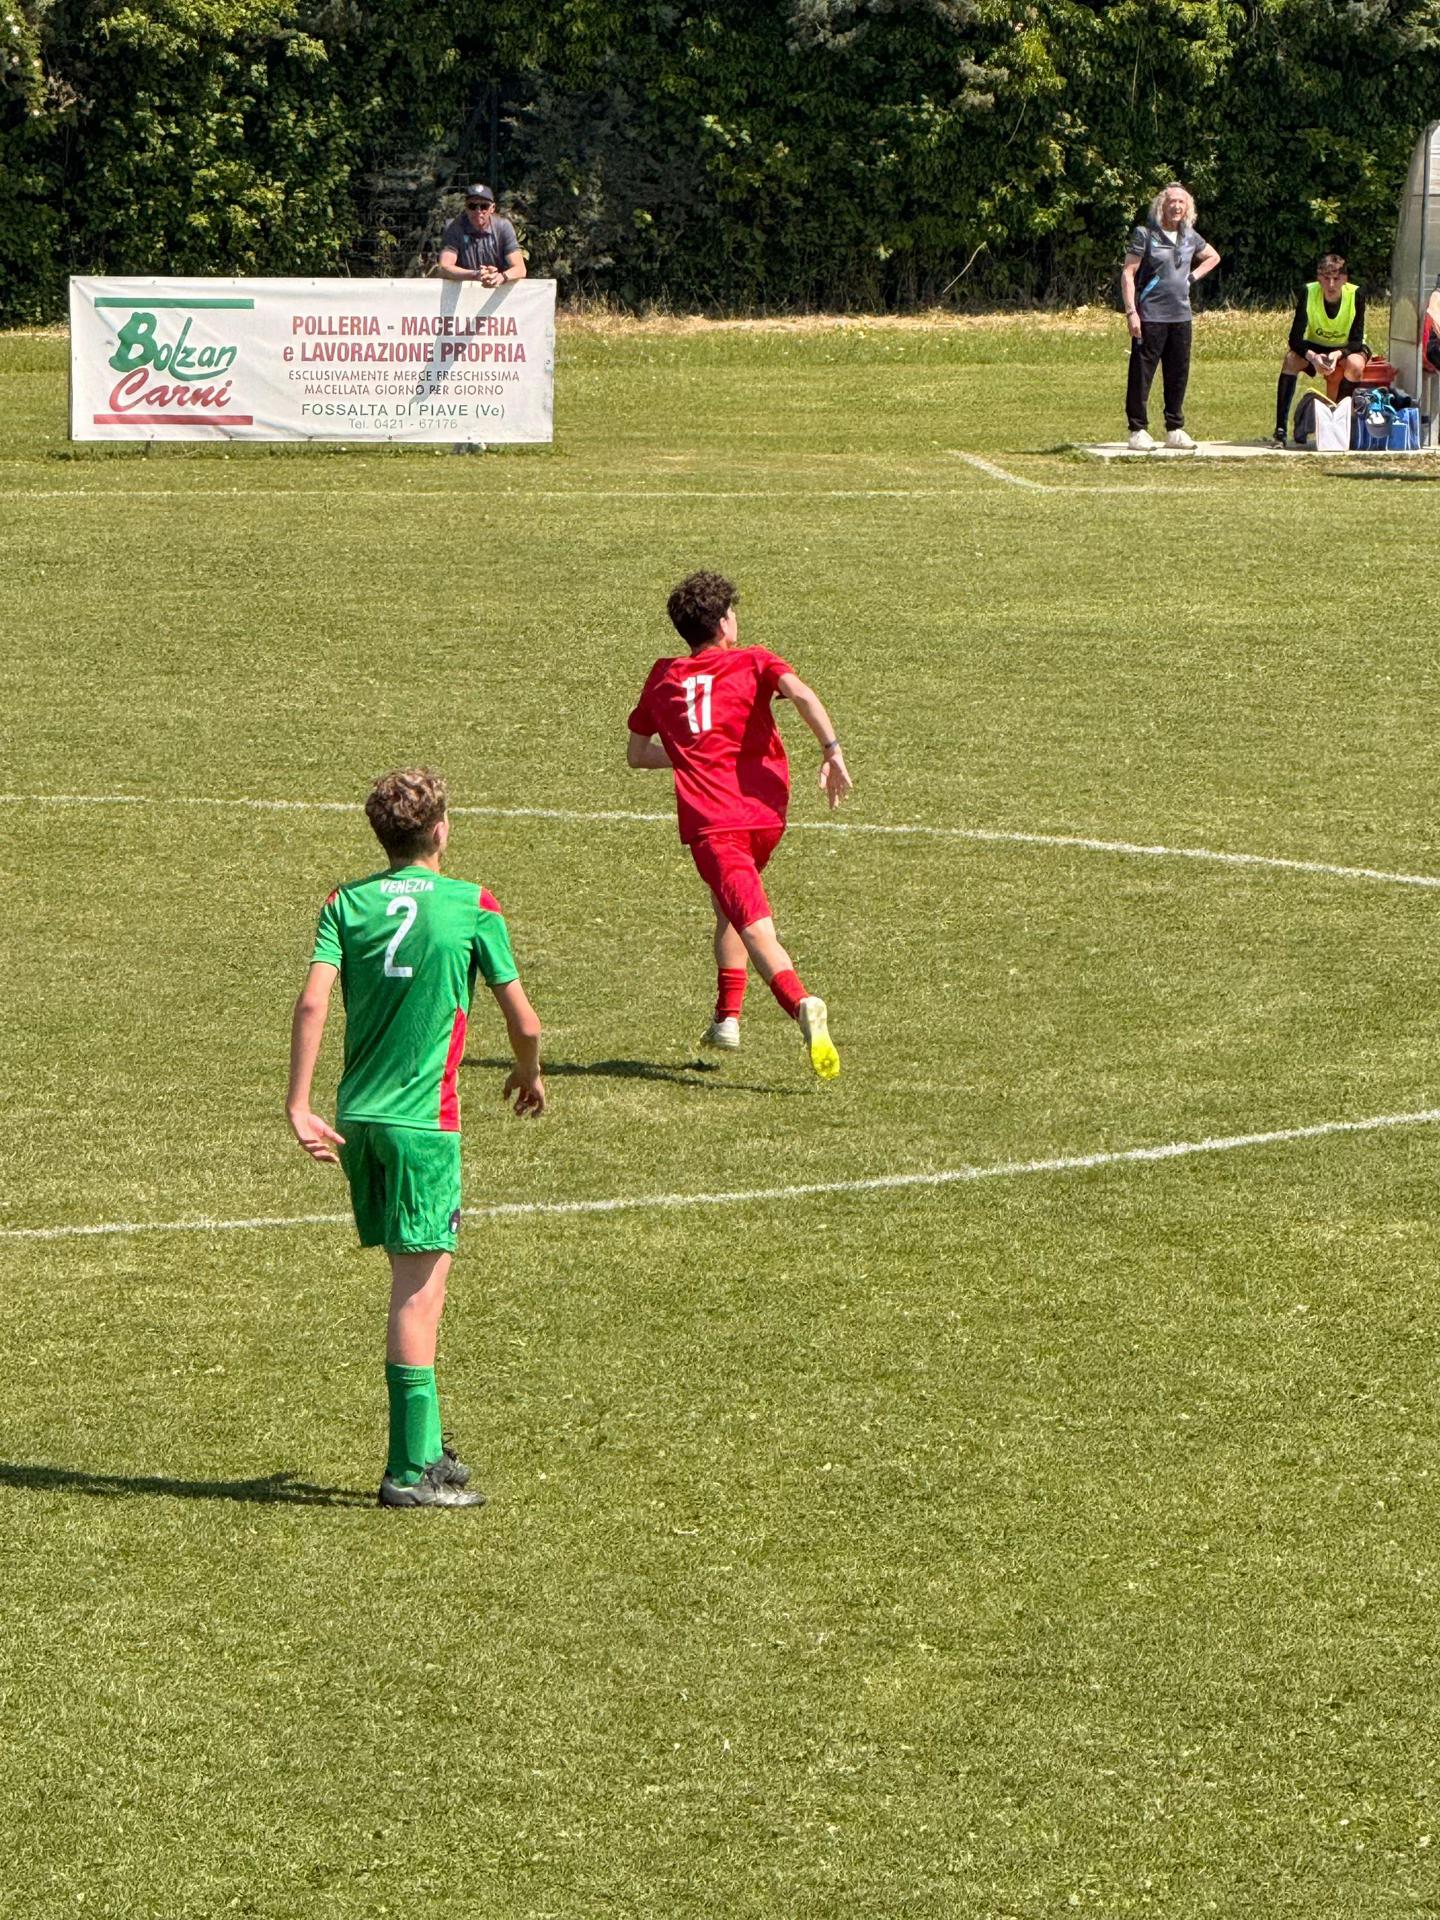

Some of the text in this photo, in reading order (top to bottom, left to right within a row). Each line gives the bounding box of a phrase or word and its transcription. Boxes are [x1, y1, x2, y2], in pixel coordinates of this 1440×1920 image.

[292, 315, 381, 336] POLLERIA
[401, 316, 518, 336] MACELLERIA
[109, 312, 238, 381] Bolzan
[283, 342, 526, 362] e LAVORAZIONE PROPRIA
[288, 370, 520, 382] ESCLUSIVAMENTE MERCE FRESCHISSIMA
[109, 367, 233, 412] Carni
[304, 384, 504, 396] MACELLATA GIORNO PER GIORNO
[301, 403, 505, 419] FOSSALTA DI PIAVE (Ve)
[348, 418, 368, 429] Tel.
[374, 418, 404, 429] 0421
[419, 418, 458, 429] 67176
[681, 674, 714, 734] 17
[379, 879, 434, 894] VENEZIA
[384, 895, 418, 978] 2
